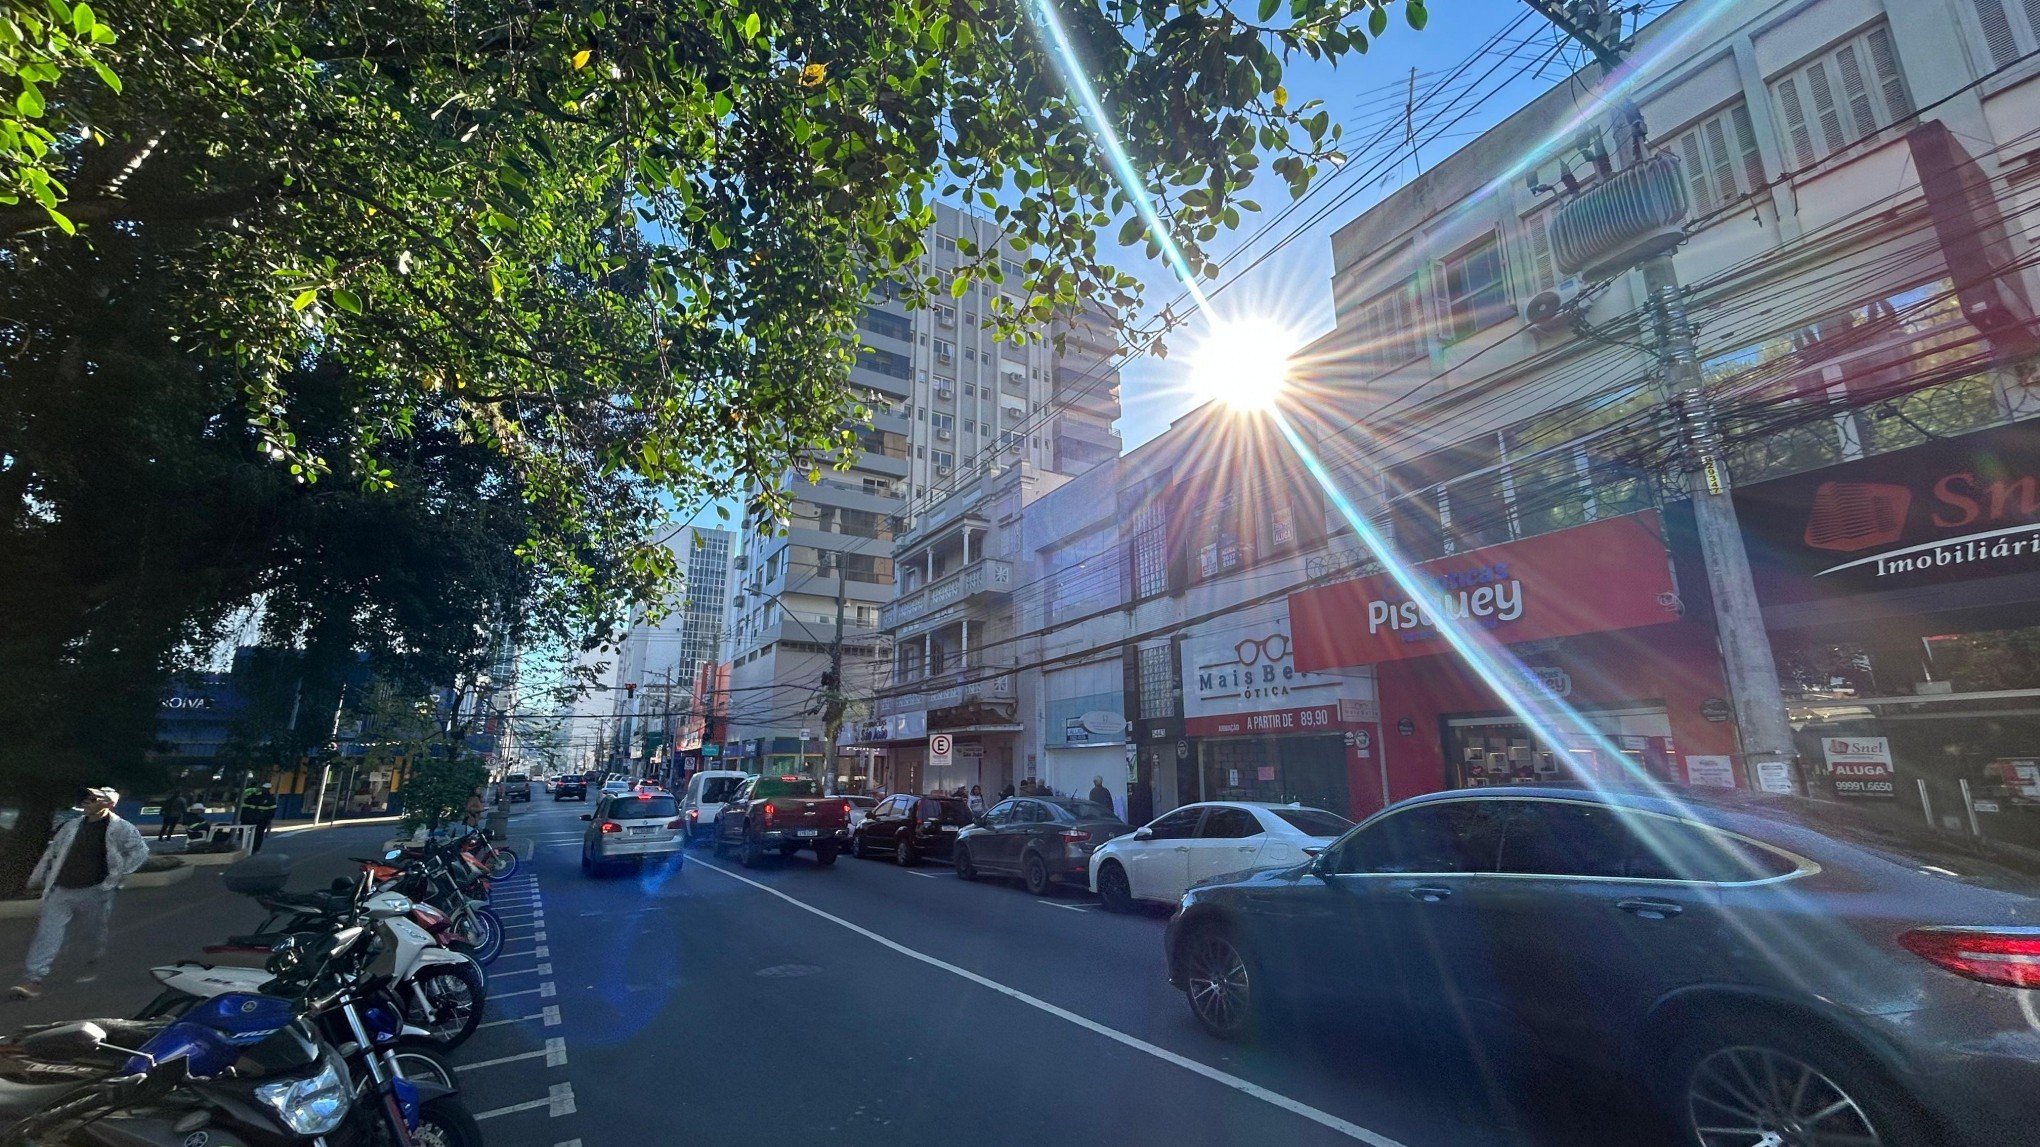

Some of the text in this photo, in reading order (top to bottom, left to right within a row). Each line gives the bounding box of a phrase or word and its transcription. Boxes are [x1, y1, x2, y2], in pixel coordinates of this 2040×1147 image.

[1199, 669, 1253, 691] Mais
[1244, 686, 1289, 699] ÓTICA
[1247, 716, 1253, 729] A
[1253, 714, 1281, 728] PARTIR
[1282, 713, 1294, 727] DE
[1300, 709, 1328, 727] 89,90
[937, 740, 945, 751] E
[1852, 741, 1883, 753] Snel
[1835, 765, 1887, 775] ALUGA
